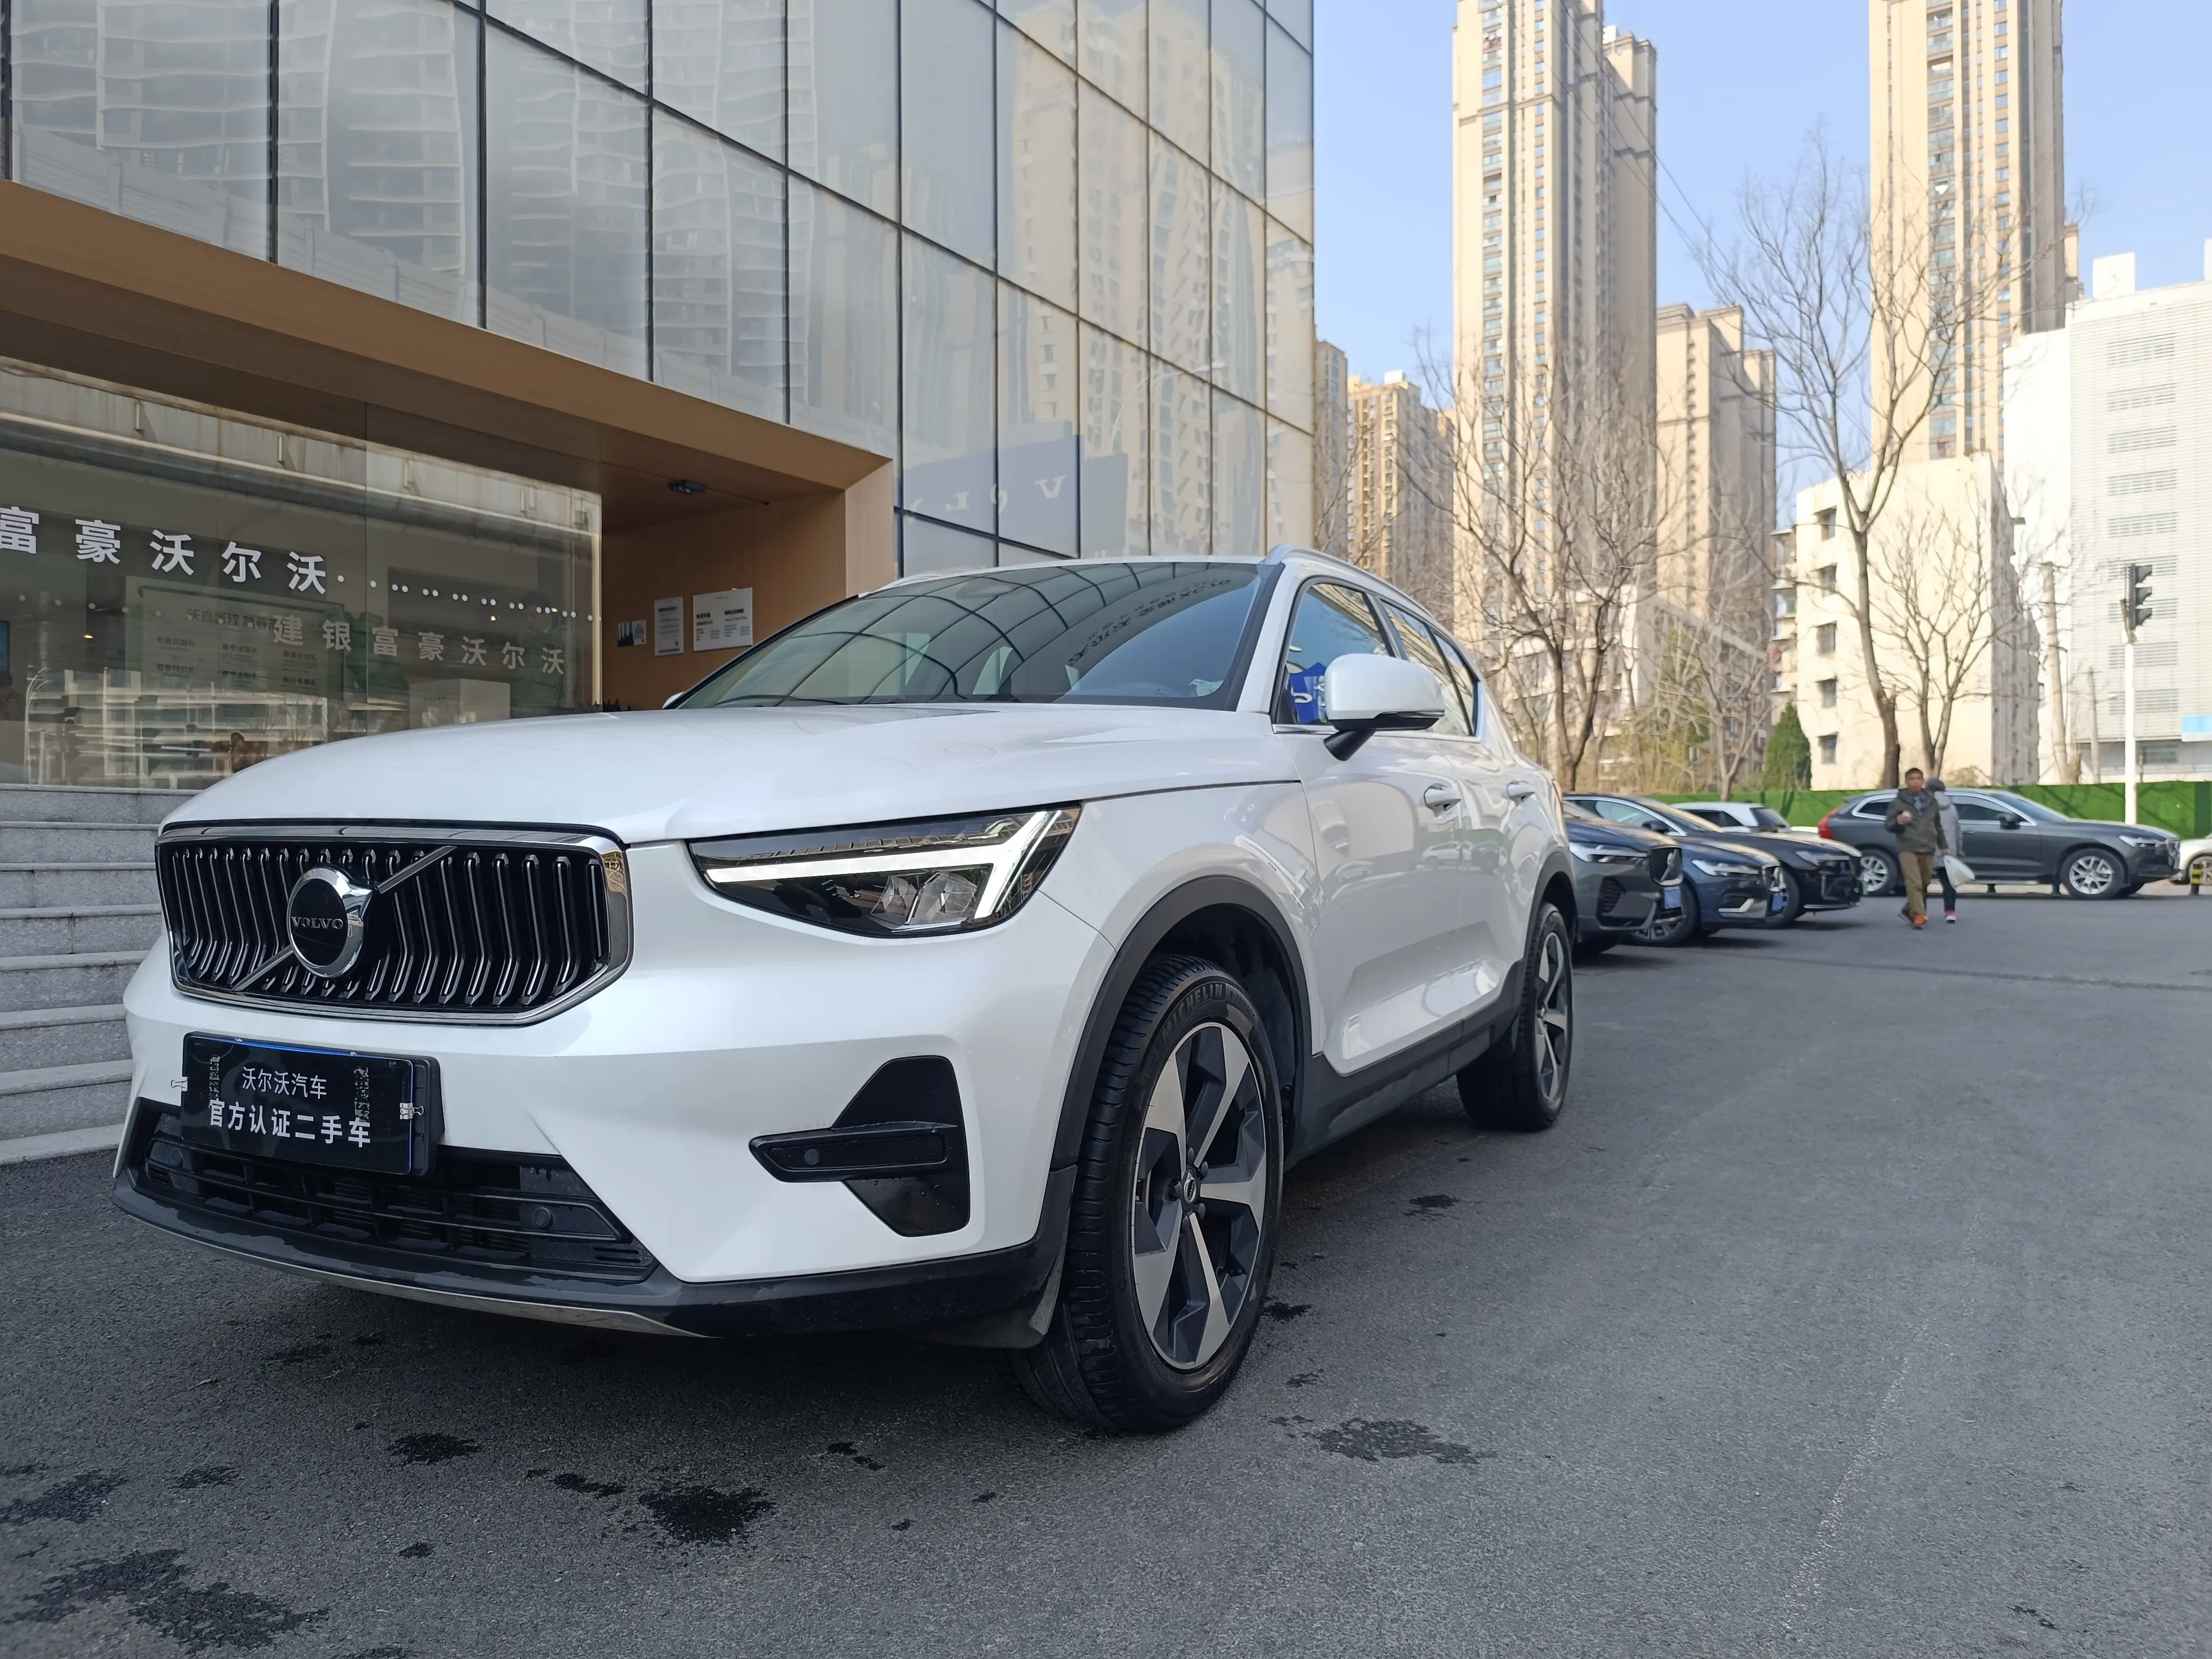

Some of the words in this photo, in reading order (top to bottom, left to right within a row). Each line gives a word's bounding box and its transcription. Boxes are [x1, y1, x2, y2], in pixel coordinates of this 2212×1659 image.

[0, 506, 326, 594] 富豪沃尔沃
[272, 614, 564, 675] 建银富豪沃尔沃
[291, 916, 344, 930] VOLVO
[1162, 983, 1223, 1043] MICHELIN
[242, 1066, 327, 1099] 沃尔沃汽车
[209, 1098, 371, 1148] 官方认证二手车
